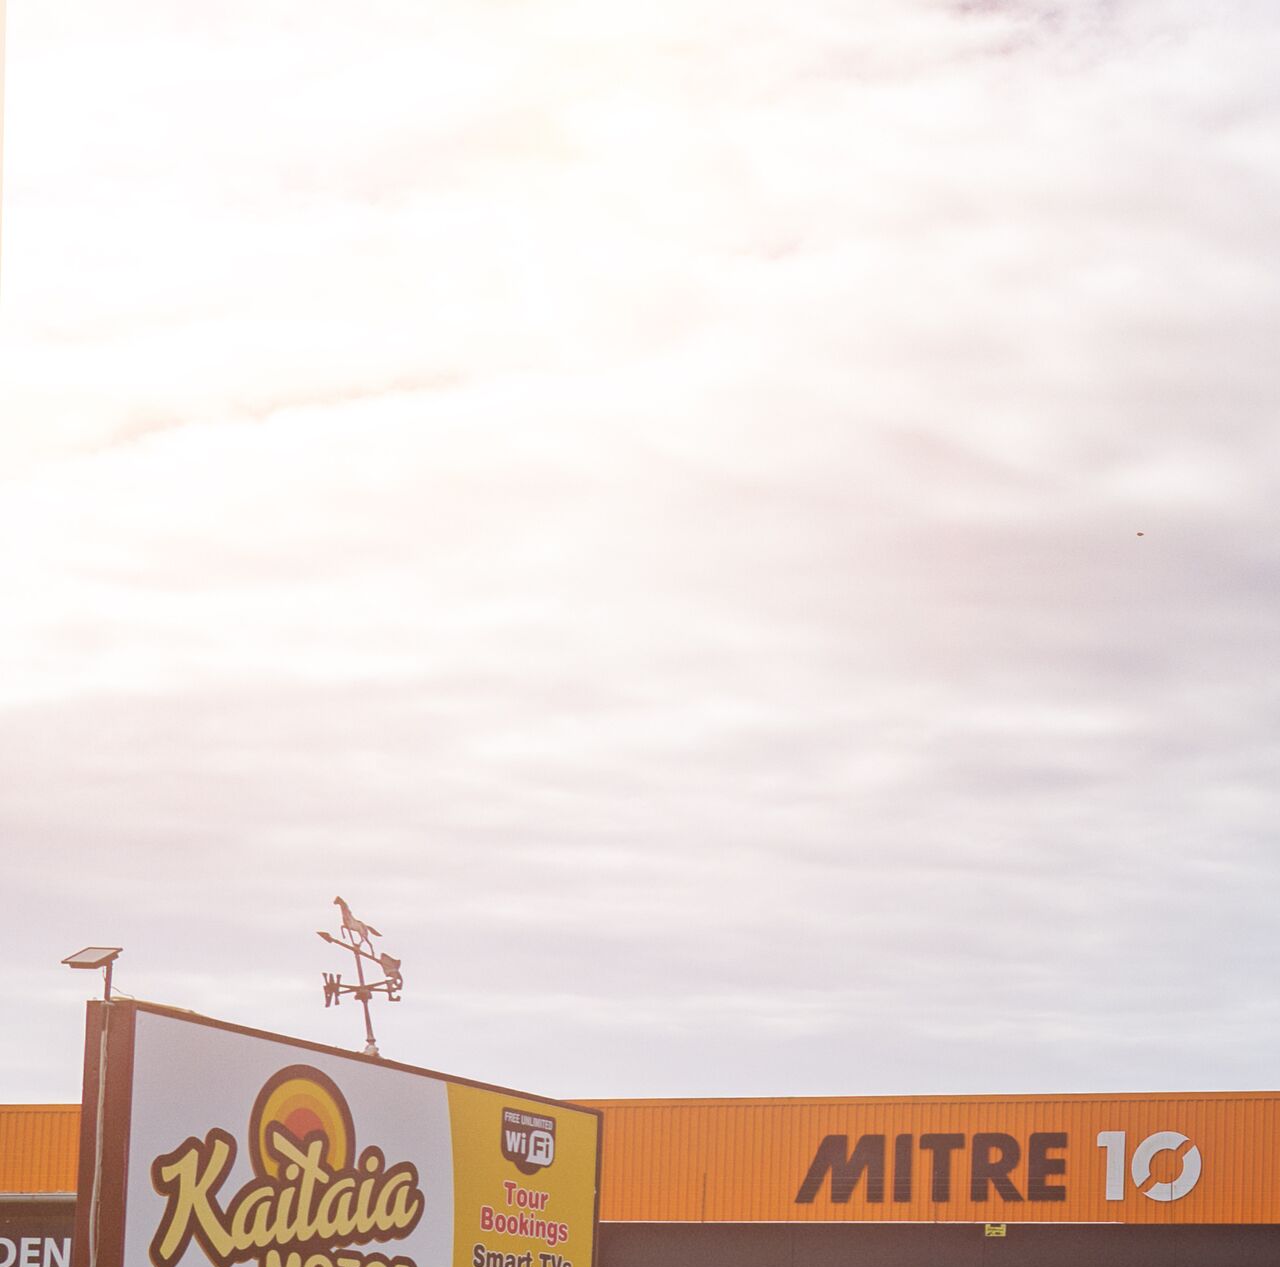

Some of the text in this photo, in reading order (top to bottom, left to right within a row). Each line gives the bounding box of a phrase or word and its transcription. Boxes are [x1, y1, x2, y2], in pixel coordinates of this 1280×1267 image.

[504, 1111, 554, 1131] FREE UNLIMITED
[794, 1131, 1202, 1204] MITRE 10
[159, 1131, 419, 1261] Kaitaia
[504, 1181, 549, 1211] Tour
[480, 1206, 569, 1246] Bookings
